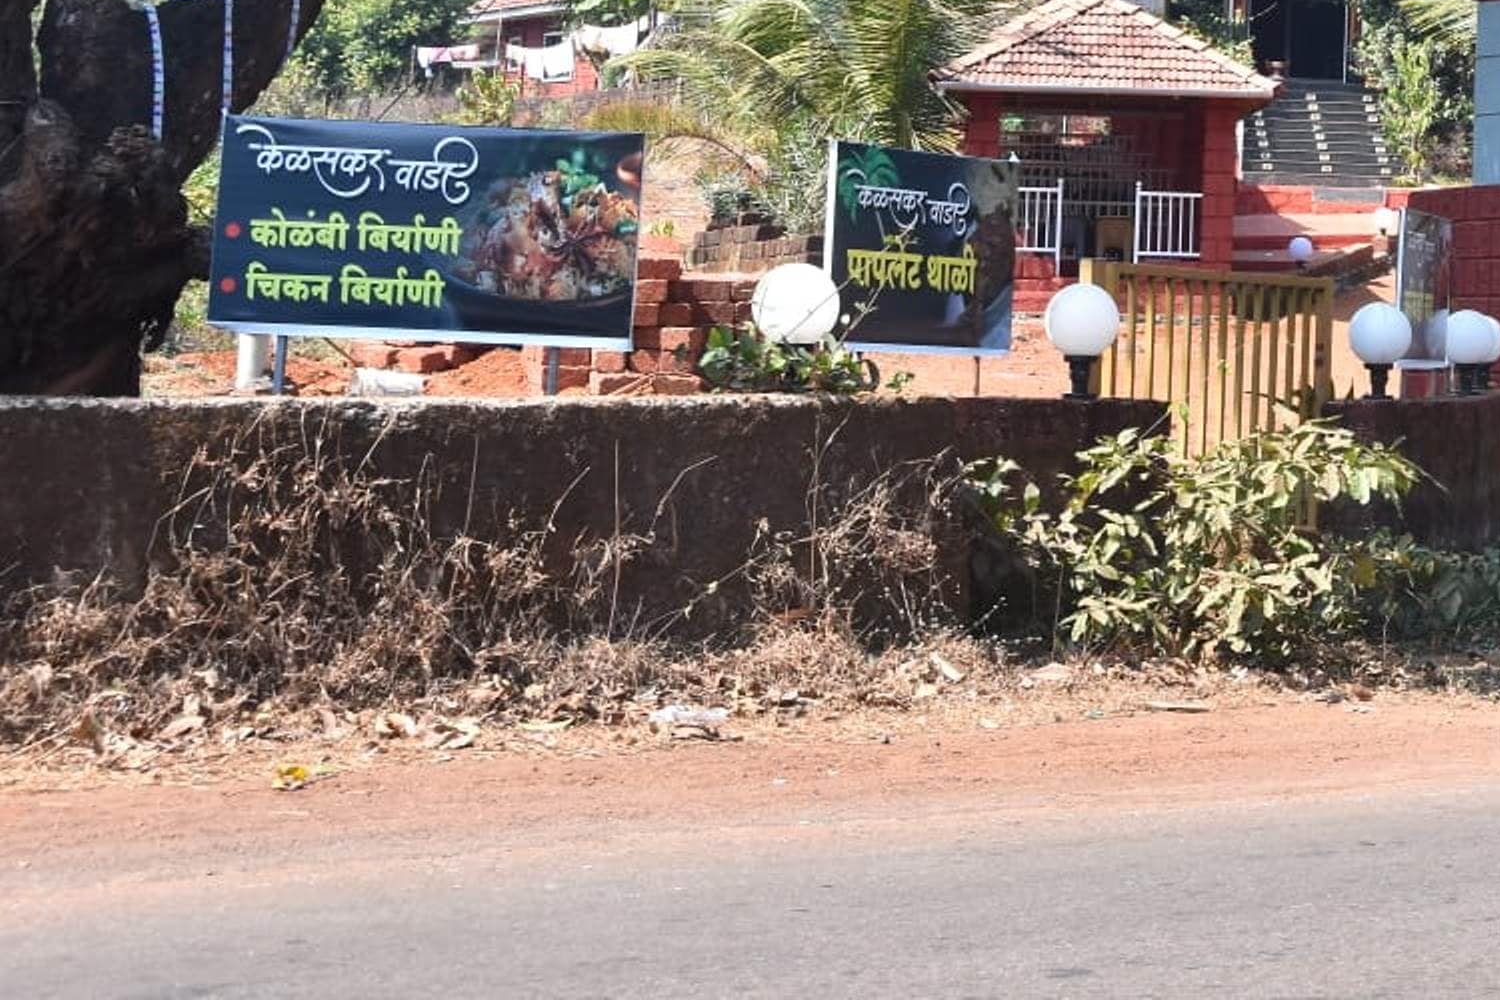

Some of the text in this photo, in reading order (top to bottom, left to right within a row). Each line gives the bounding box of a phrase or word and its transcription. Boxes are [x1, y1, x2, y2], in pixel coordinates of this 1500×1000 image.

[236, 123, 479, 205] केळसकर वाडी
[250, 208, 463, 257] कोळंबी बिर्याणी
[926, 182, 970, 236] वाडी
[246, 262, 446, 309] चिकन बिर्याणी
[926, 243, 978, 295] थाळी
